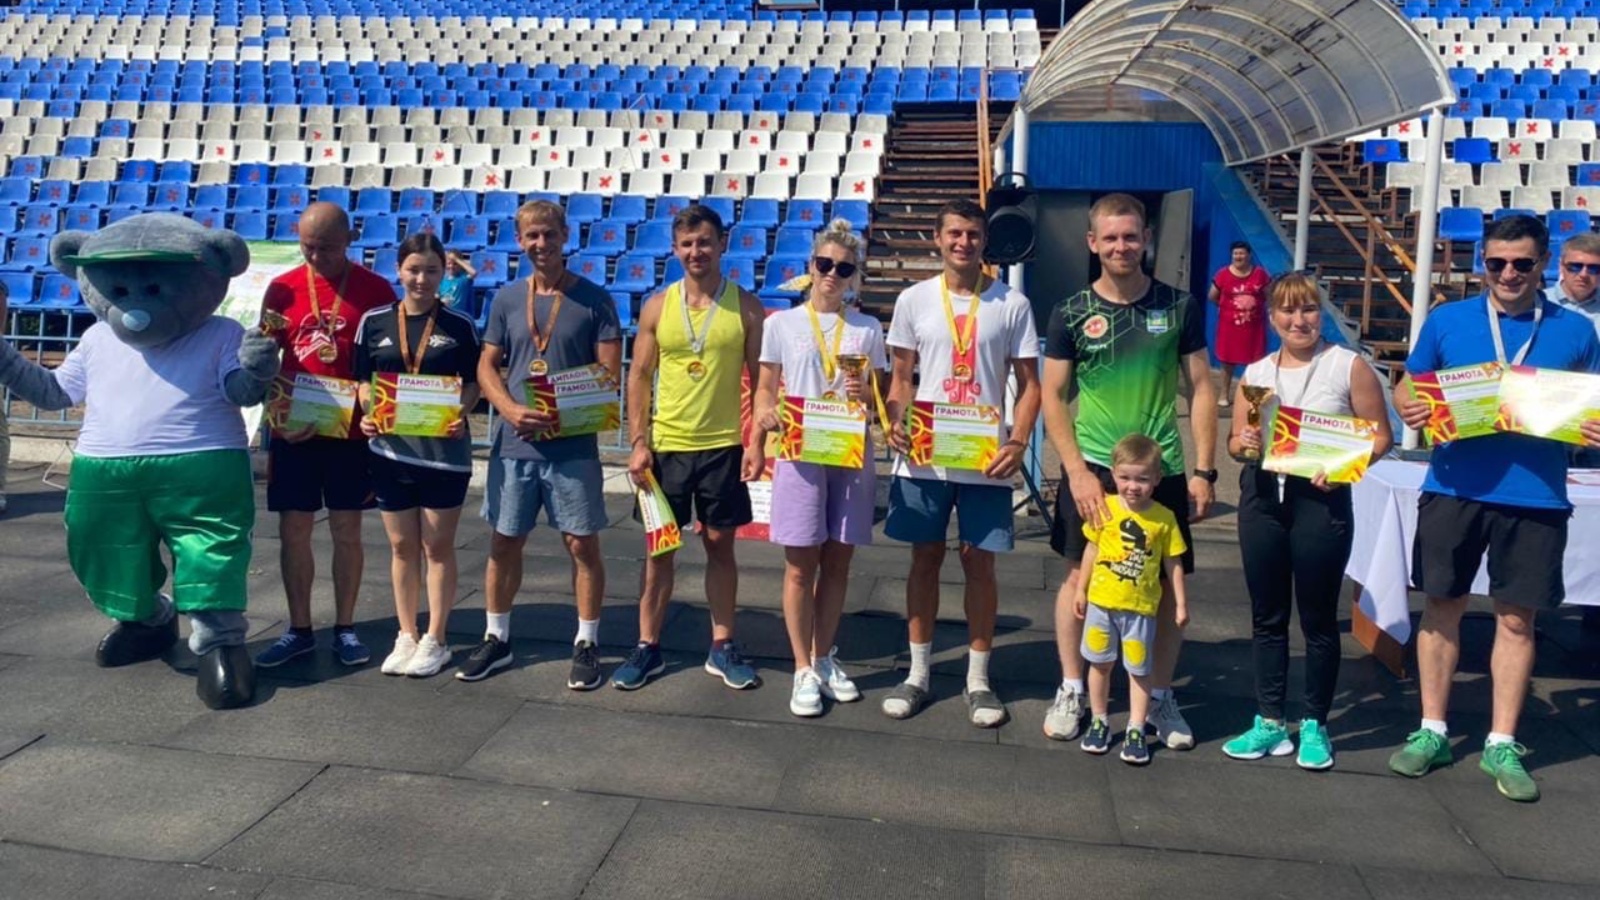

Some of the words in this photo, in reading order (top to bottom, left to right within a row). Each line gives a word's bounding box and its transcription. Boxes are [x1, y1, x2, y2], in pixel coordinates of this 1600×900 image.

[551, 370, 589, 382] ДИПЛОМ
[1440, 370, 1484, 382] ГРАМОТА
[297, 376, 338, 389] ГРАМОТА
[400, 378, 440, 387] ГРАМОТА
[557, 382, 596, 393] ГРАМОТА
[806, 402, 845, 412] ГРАМОТА
[935, 407, 977, 417] ГРАМОТА
[1304, 414, 1351, 431] ГРАМОТА
